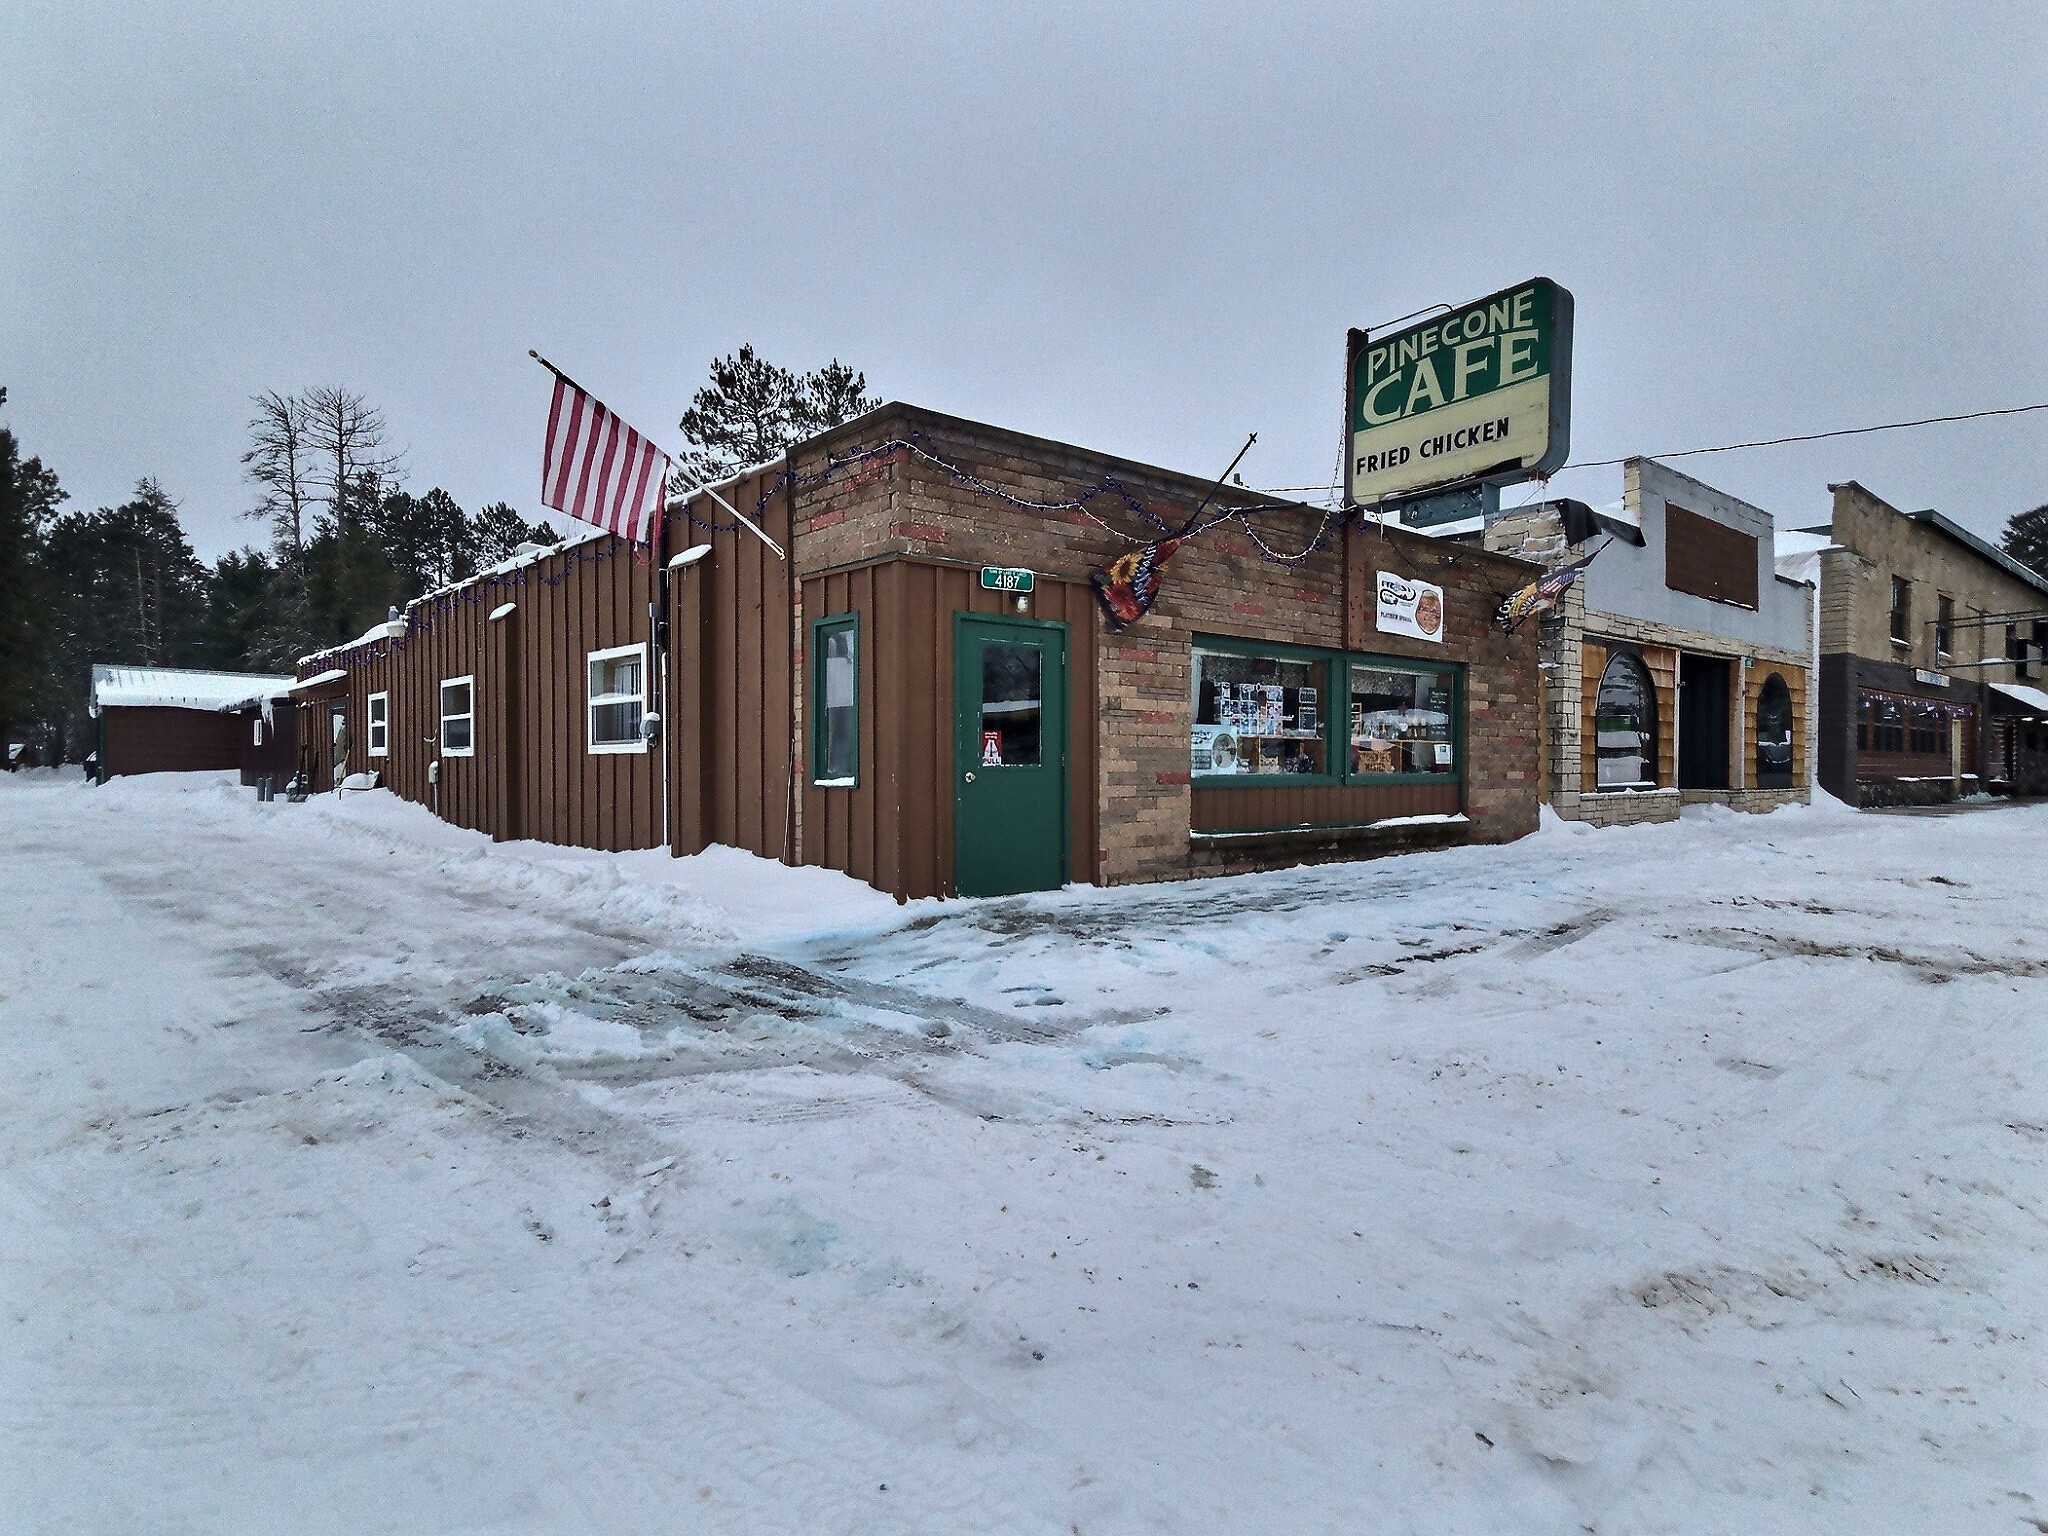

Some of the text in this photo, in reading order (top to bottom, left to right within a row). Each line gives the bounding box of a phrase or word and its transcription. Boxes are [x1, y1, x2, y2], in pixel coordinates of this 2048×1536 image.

[1367, 288, 1535, 386] PINECONE
[1362, 328, 1539, 426] CAFE
[1356, 417, 1510, 475] FRIED CHICKEN
[995, 574, 1020, 588] 4187
